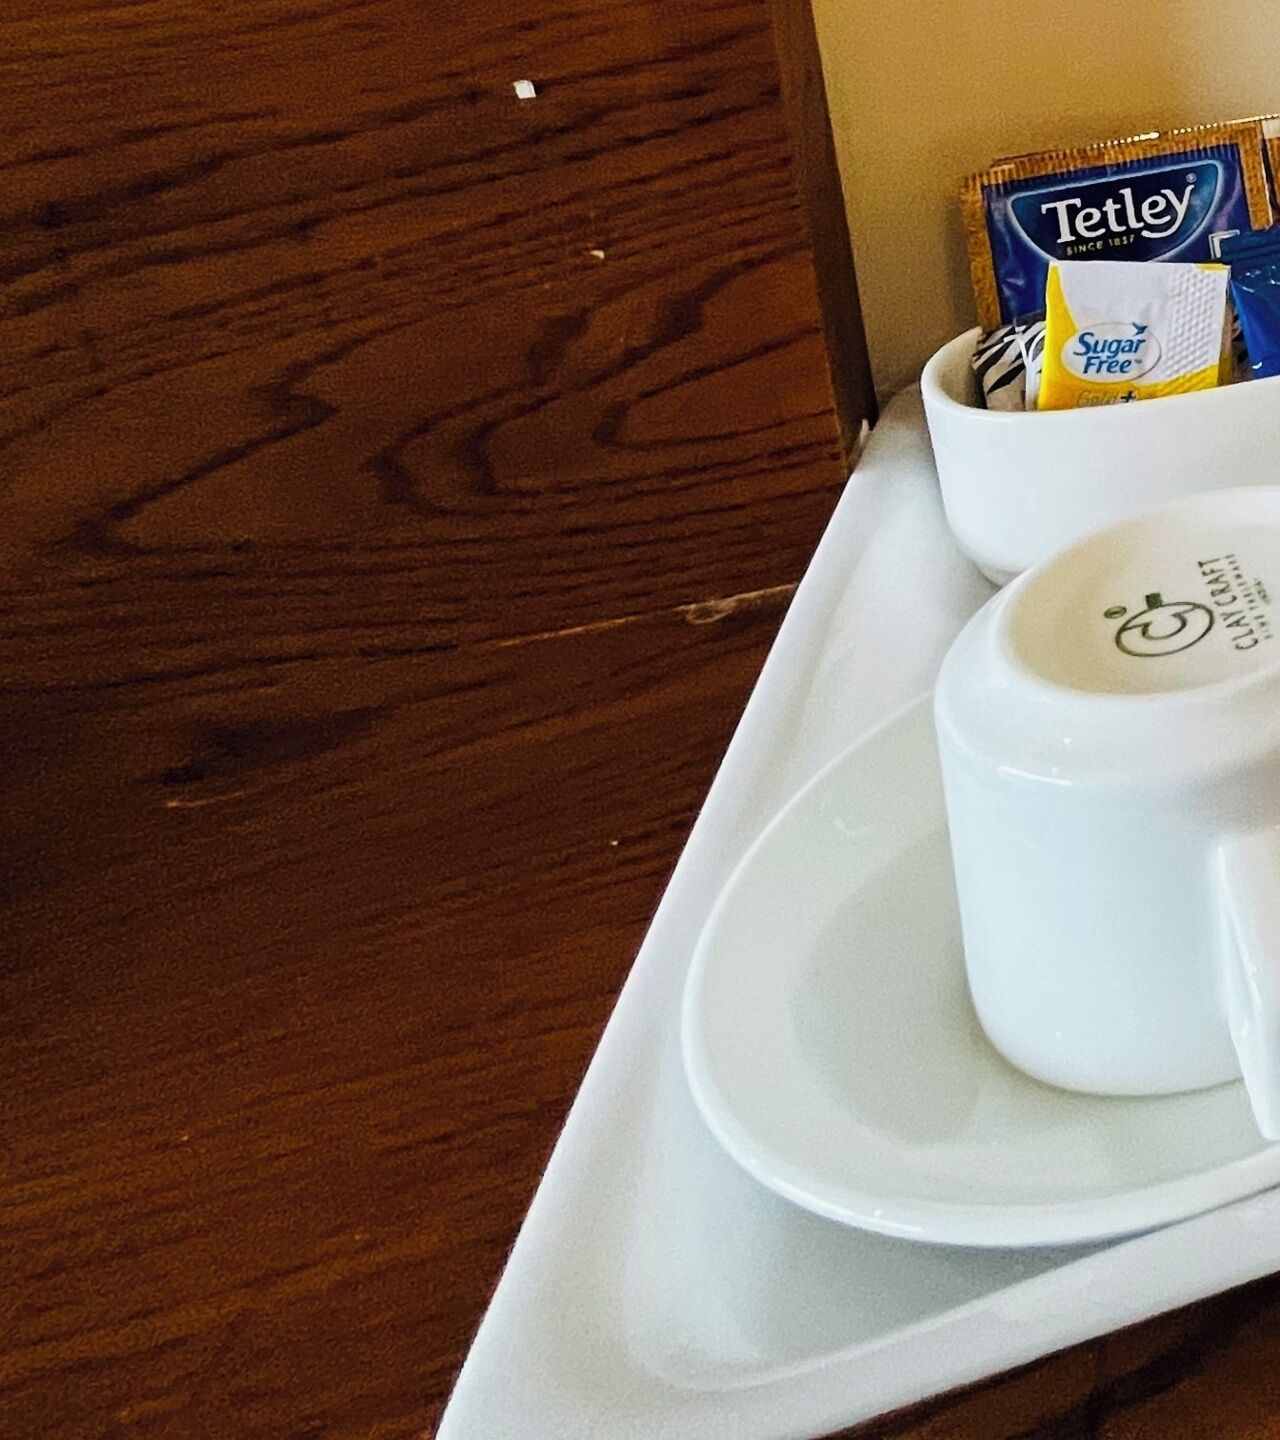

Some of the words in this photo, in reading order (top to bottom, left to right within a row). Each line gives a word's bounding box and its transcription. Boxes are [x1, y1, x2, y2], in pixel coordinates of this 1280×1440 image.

[1041, 184, 1195, 244] Tetley
[1066, 240, 1104, 256] SINCE
[1108, 234, 1135, 247] 1837
[1073, 332, 1147, 359] Sugar
[1082, 356, 1132, 374] Free
[1197, 557, 1238, 607] CRAFT
[1219, 610, 1259, 650] CLAY
